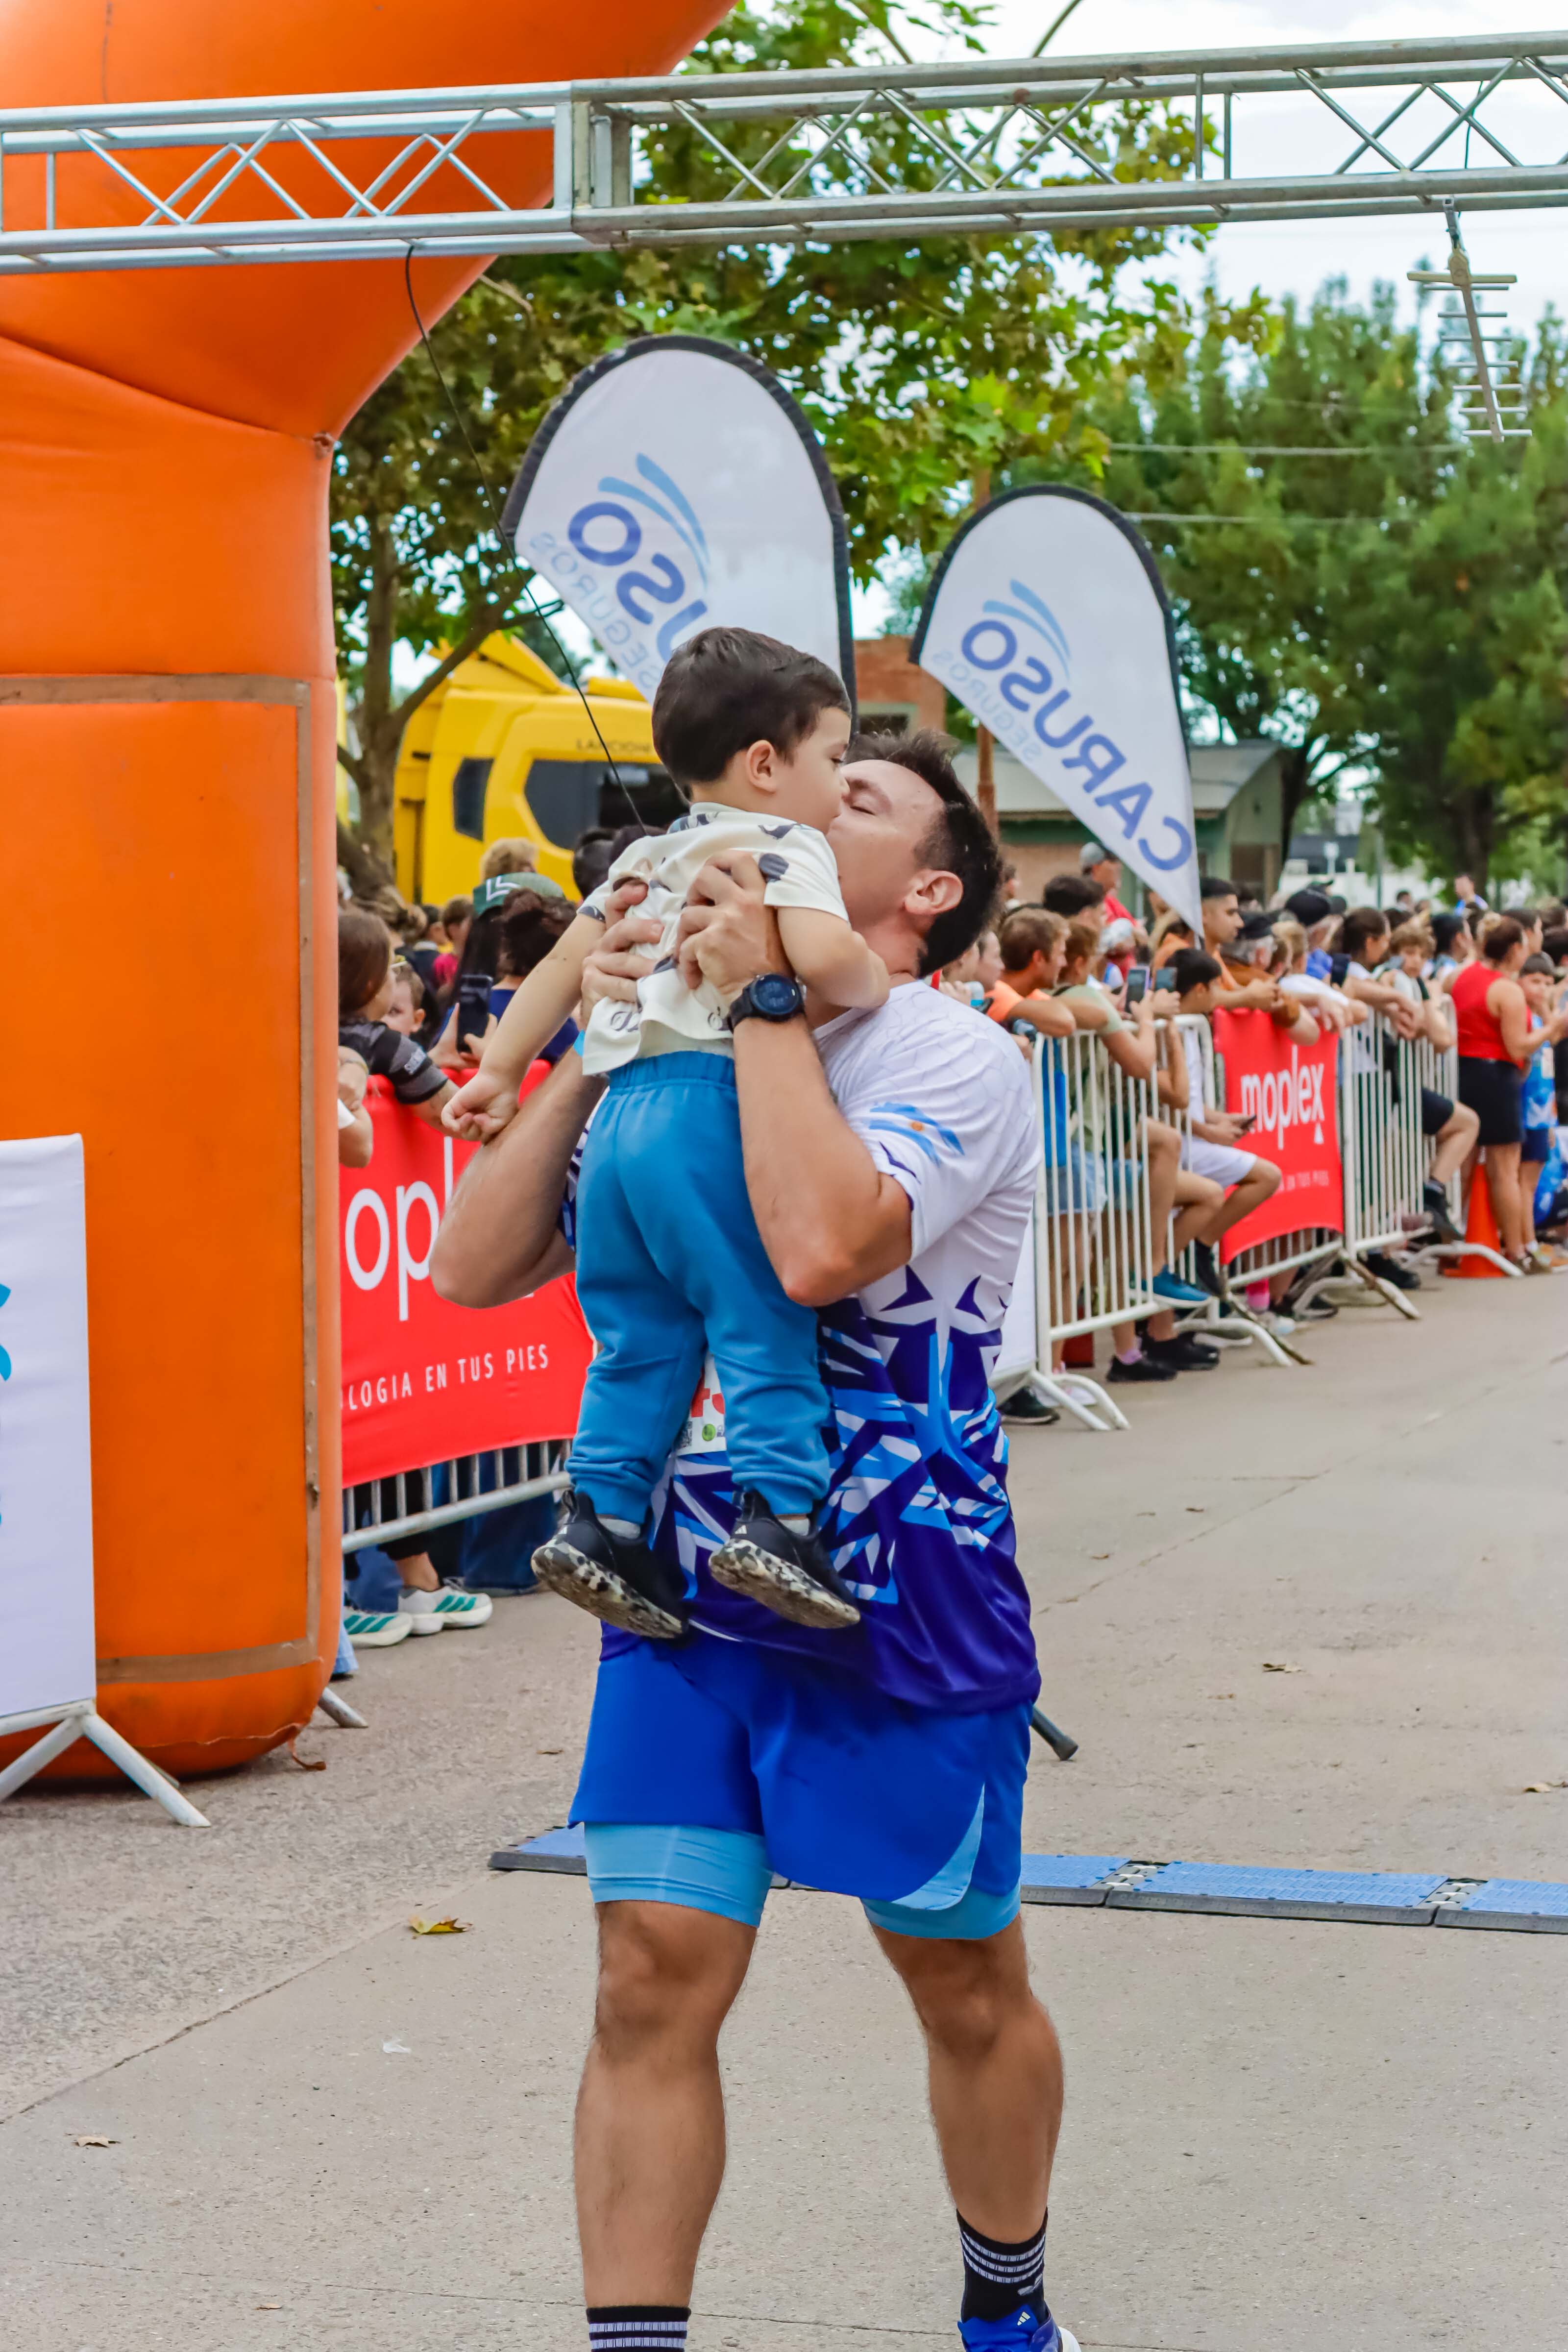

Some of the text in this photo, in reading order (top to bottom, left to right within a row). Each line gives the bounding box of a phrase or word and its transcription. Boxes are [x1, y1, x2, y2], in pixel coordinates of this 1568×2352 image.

[1241, 1044, 1325, 1151] moplex
[340, 1344, 548, 1410] LOGIA EN TUS PIES
